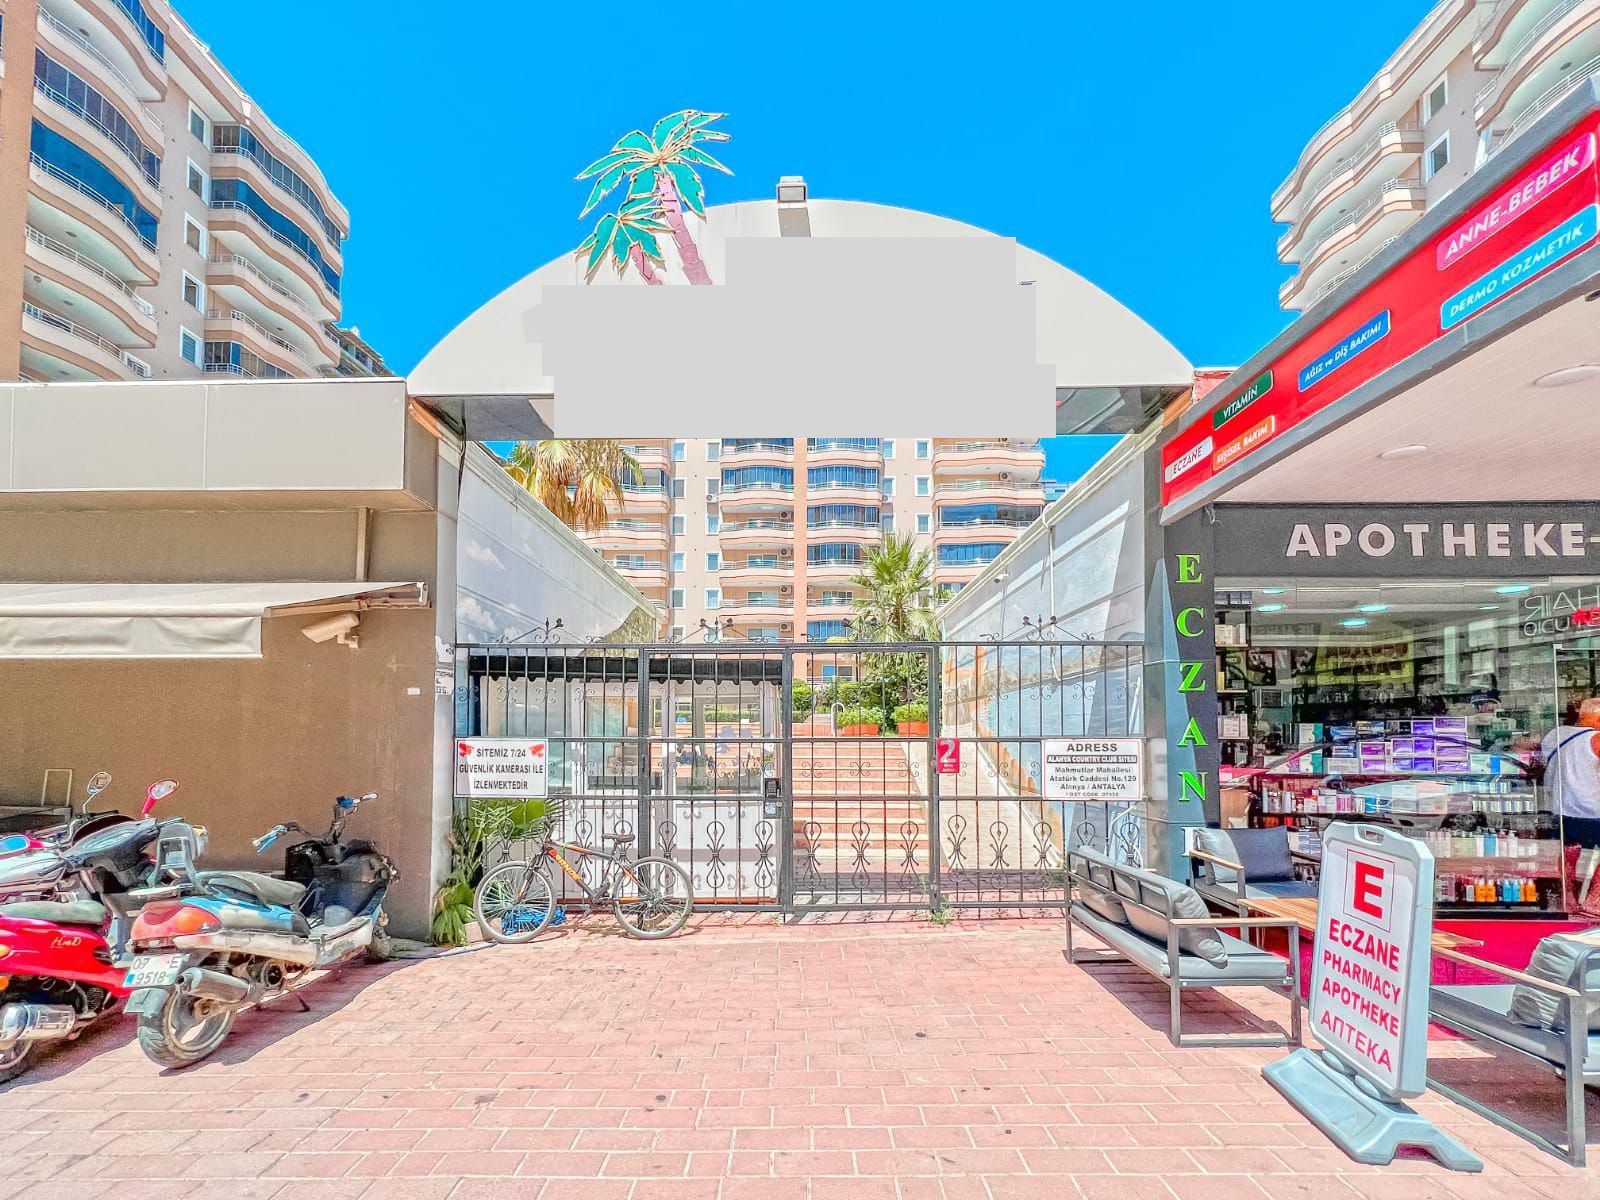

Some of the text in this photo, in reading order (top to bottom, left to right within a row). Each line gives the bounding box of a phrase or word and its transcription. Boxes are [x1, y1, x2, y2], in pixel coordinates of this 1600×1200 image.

[1444, 146, 1580, 260] ANNE-BEBEK
[1449, 279, 1498, 317] DERMO
[1223, 384, 1258, 419] VİTAMİN
[1173, 446, 1203, 475] ECZANE
[510, 748, 526, 757] 7/24
[940, 739, 956, 763] 2
[1066, 743, 1118, 752] ADRESS
[496, 764, 531, 773] KAMERASI
[1353, 860, 1384, 920] E
[1328, 918, 1400, 973] ECZANE
[1323, 949, 1402, 1005] PHARMACY
[1321, 977, 1400, 1038] APOTHEKE
[1320, 1009, 1392, 1073] АПТЕКА
